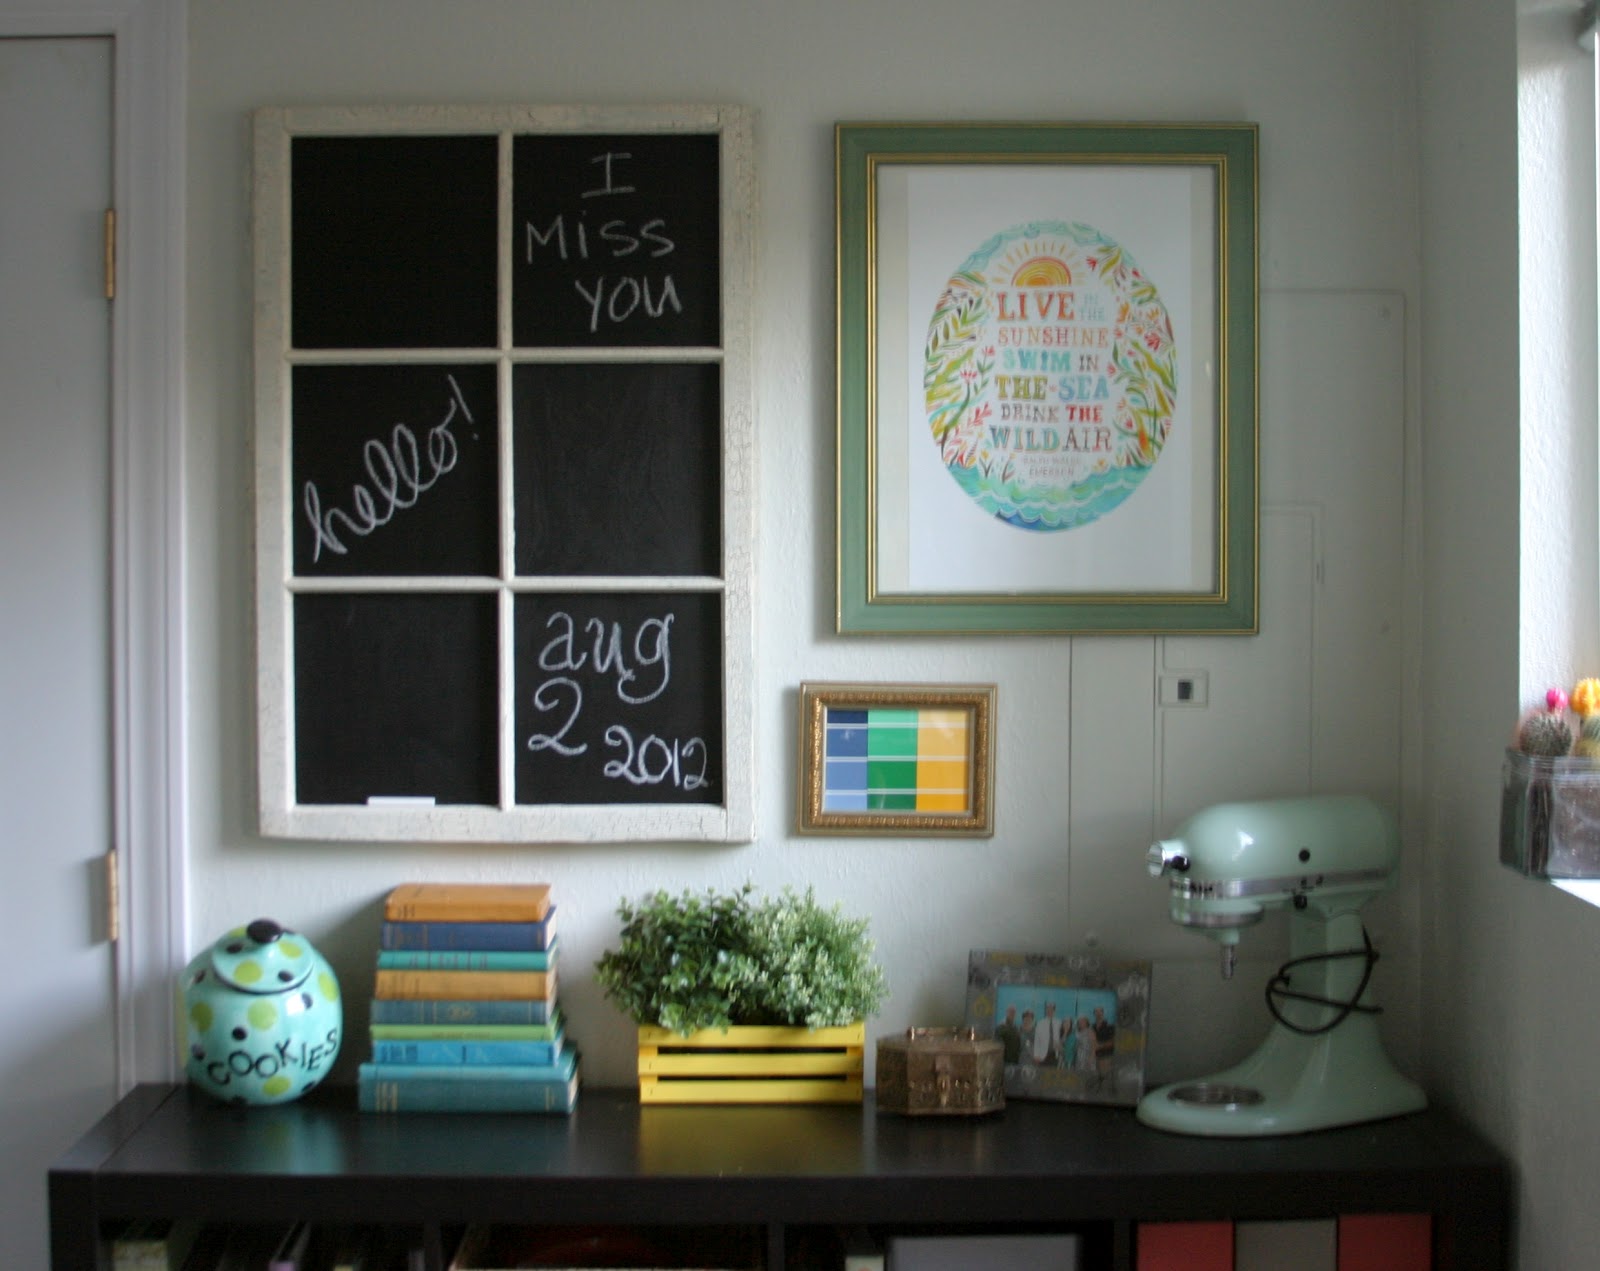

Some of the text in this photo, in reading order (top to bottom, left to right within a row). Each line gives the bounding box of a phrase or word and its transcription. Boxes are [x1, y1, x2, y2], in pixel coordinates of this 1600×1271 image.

[582, 151, 635, 199] I
[996, 290, 1075, 321] LIVE
[998, 326, 1109, 347] SUNSHINE
[1002, 348, 1099, 373] SWIM IN
[994, 375, 1110, 401] THE SEA
[1001, 403, 1104, 423] DRINK THE
[989, 425, 1113, 453] WILD AIR
[527, 676, 588, 757] 2
[603, 724, 709, 791] 2012
[206, 1027, 338, 1086] COOKIES
